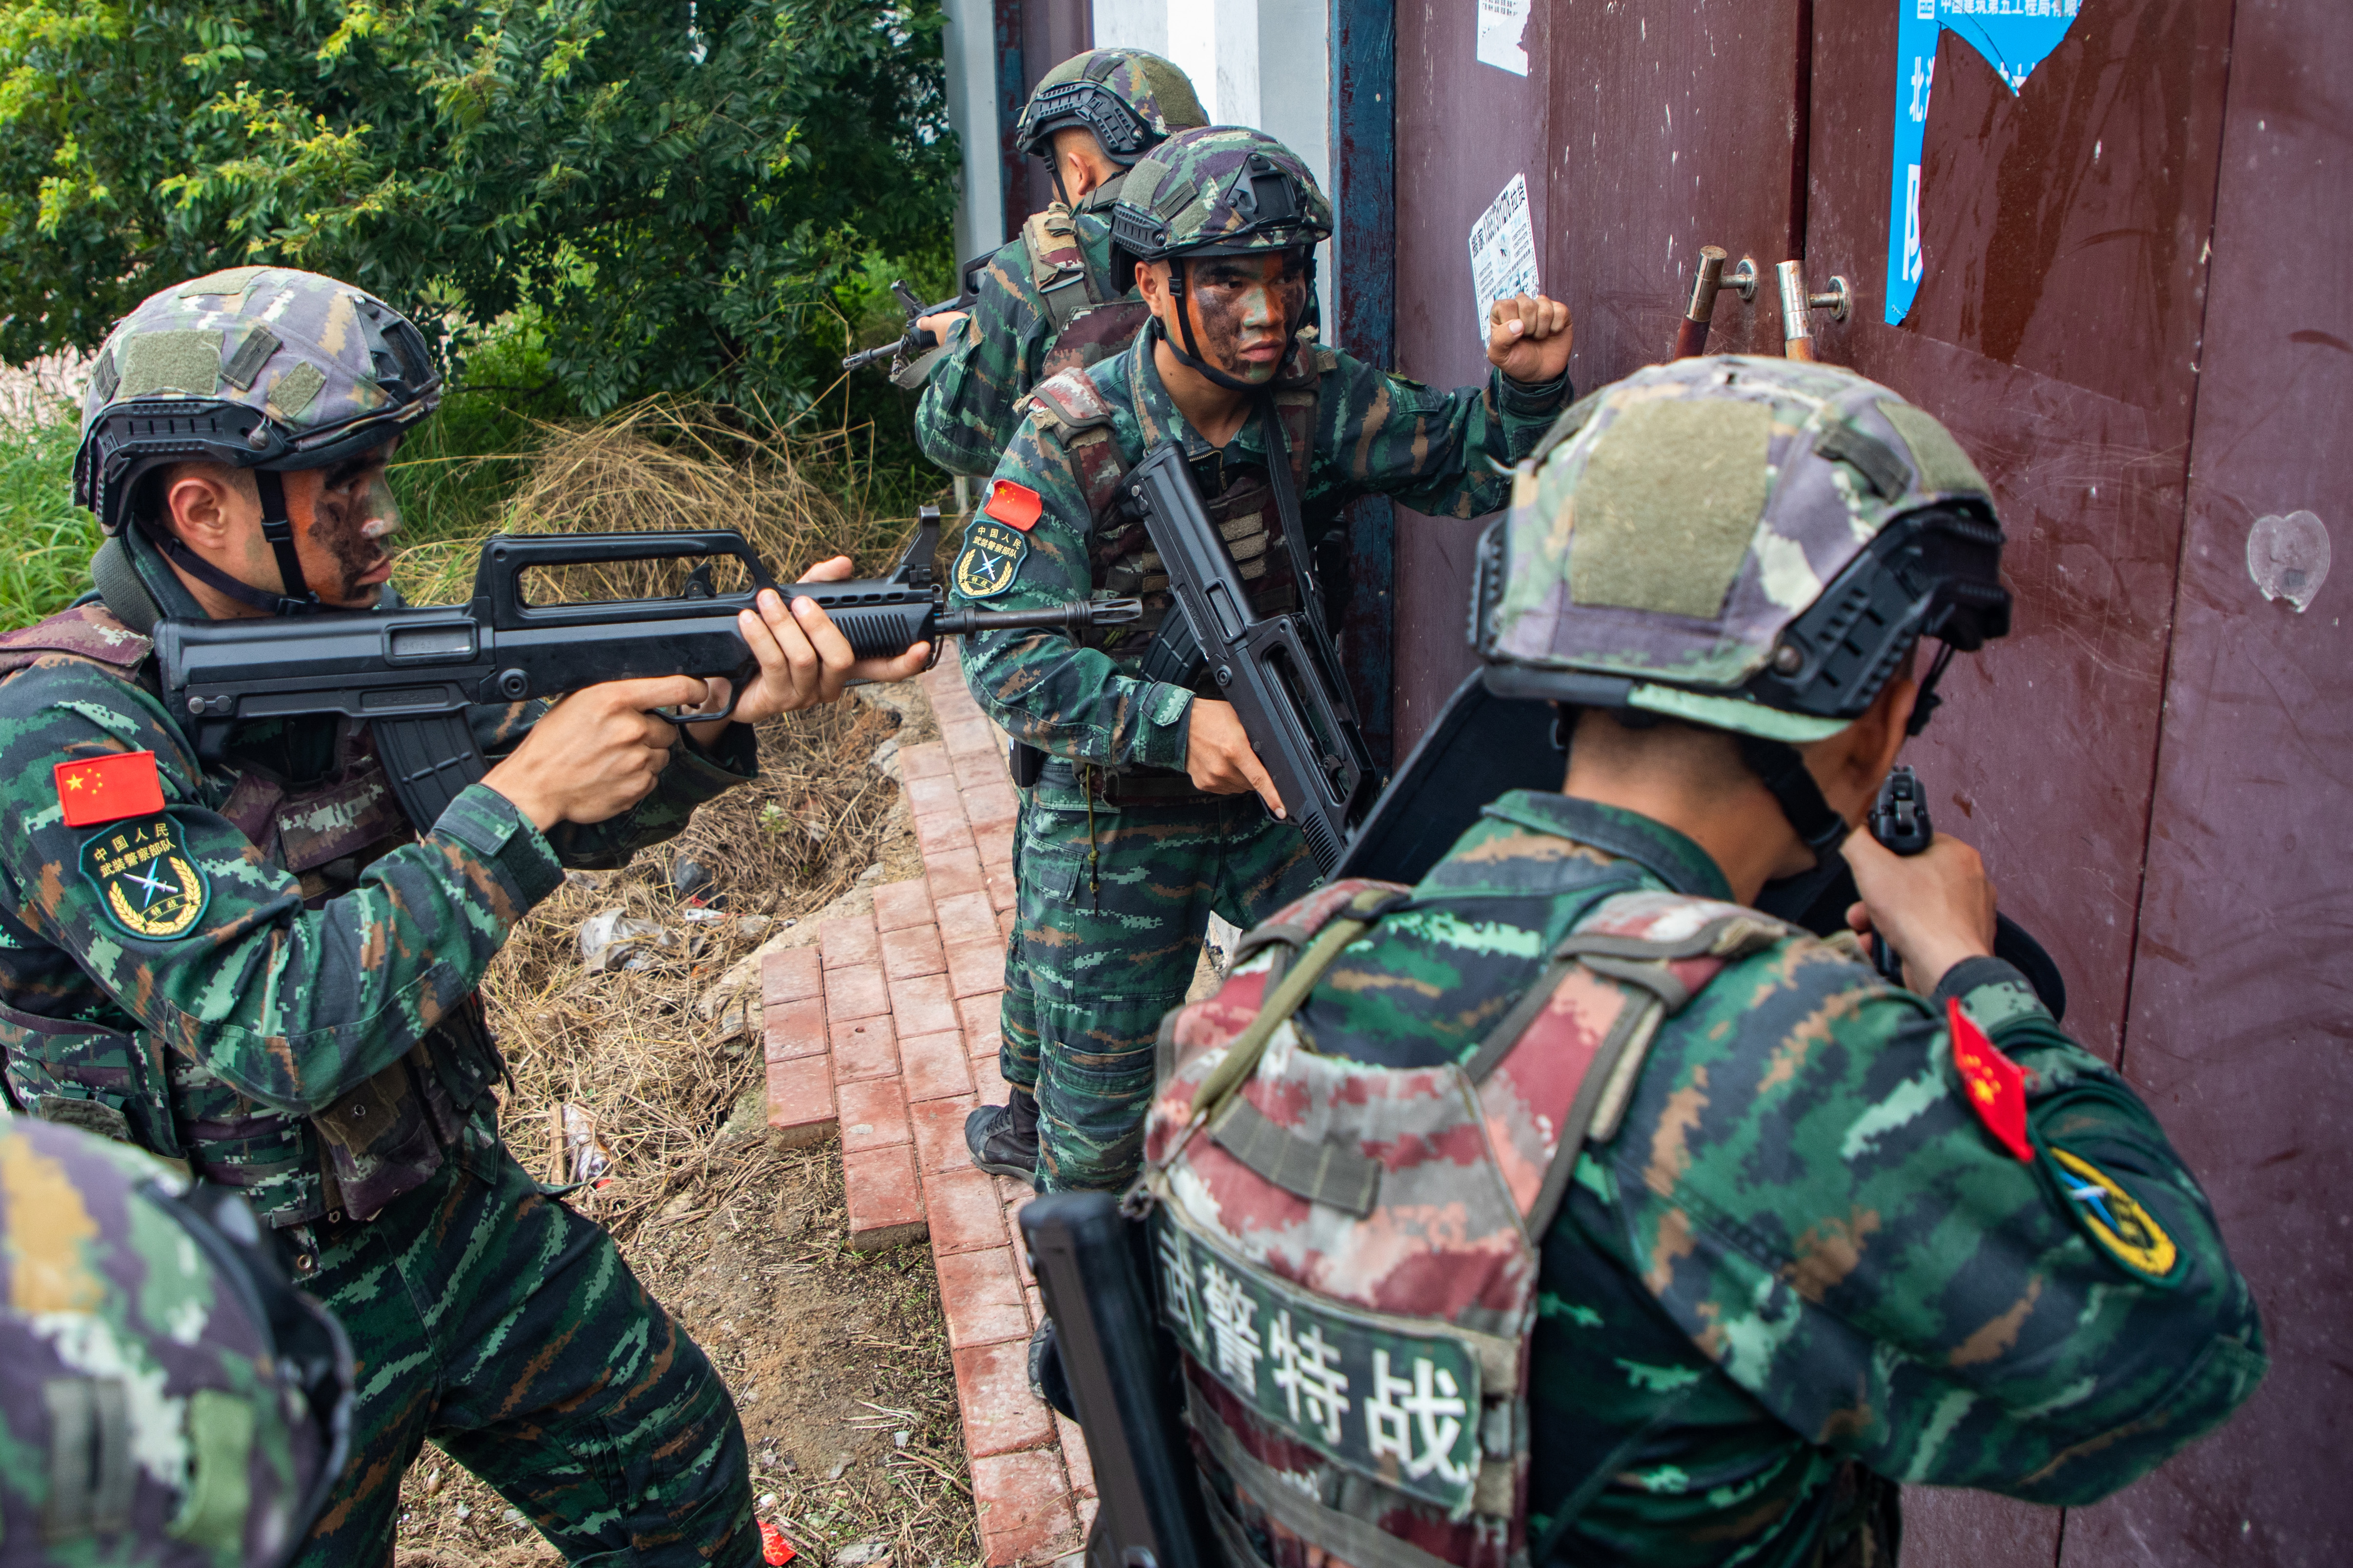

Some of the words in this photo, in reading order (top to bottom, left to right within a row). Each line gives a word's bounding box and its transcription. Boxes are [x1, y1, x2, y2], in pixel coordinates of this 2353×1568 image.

[1941, 0, 2083, 17] 中国建筑第五工程局有限
[1510, 180, 1525, 213] 拉货
[973, 536, 1017, 559] 武装警察部队
[977, 526, 1022, 549] 中国人民
[971, 577, 988, 586] 特战
[94, 823, 169, 862] 中国人民
[100, 838, 176, 878] 武装警察部队
[150, 899, 179, 917] 特战
[1157, 1228, 1470, 1486] 武警特战
